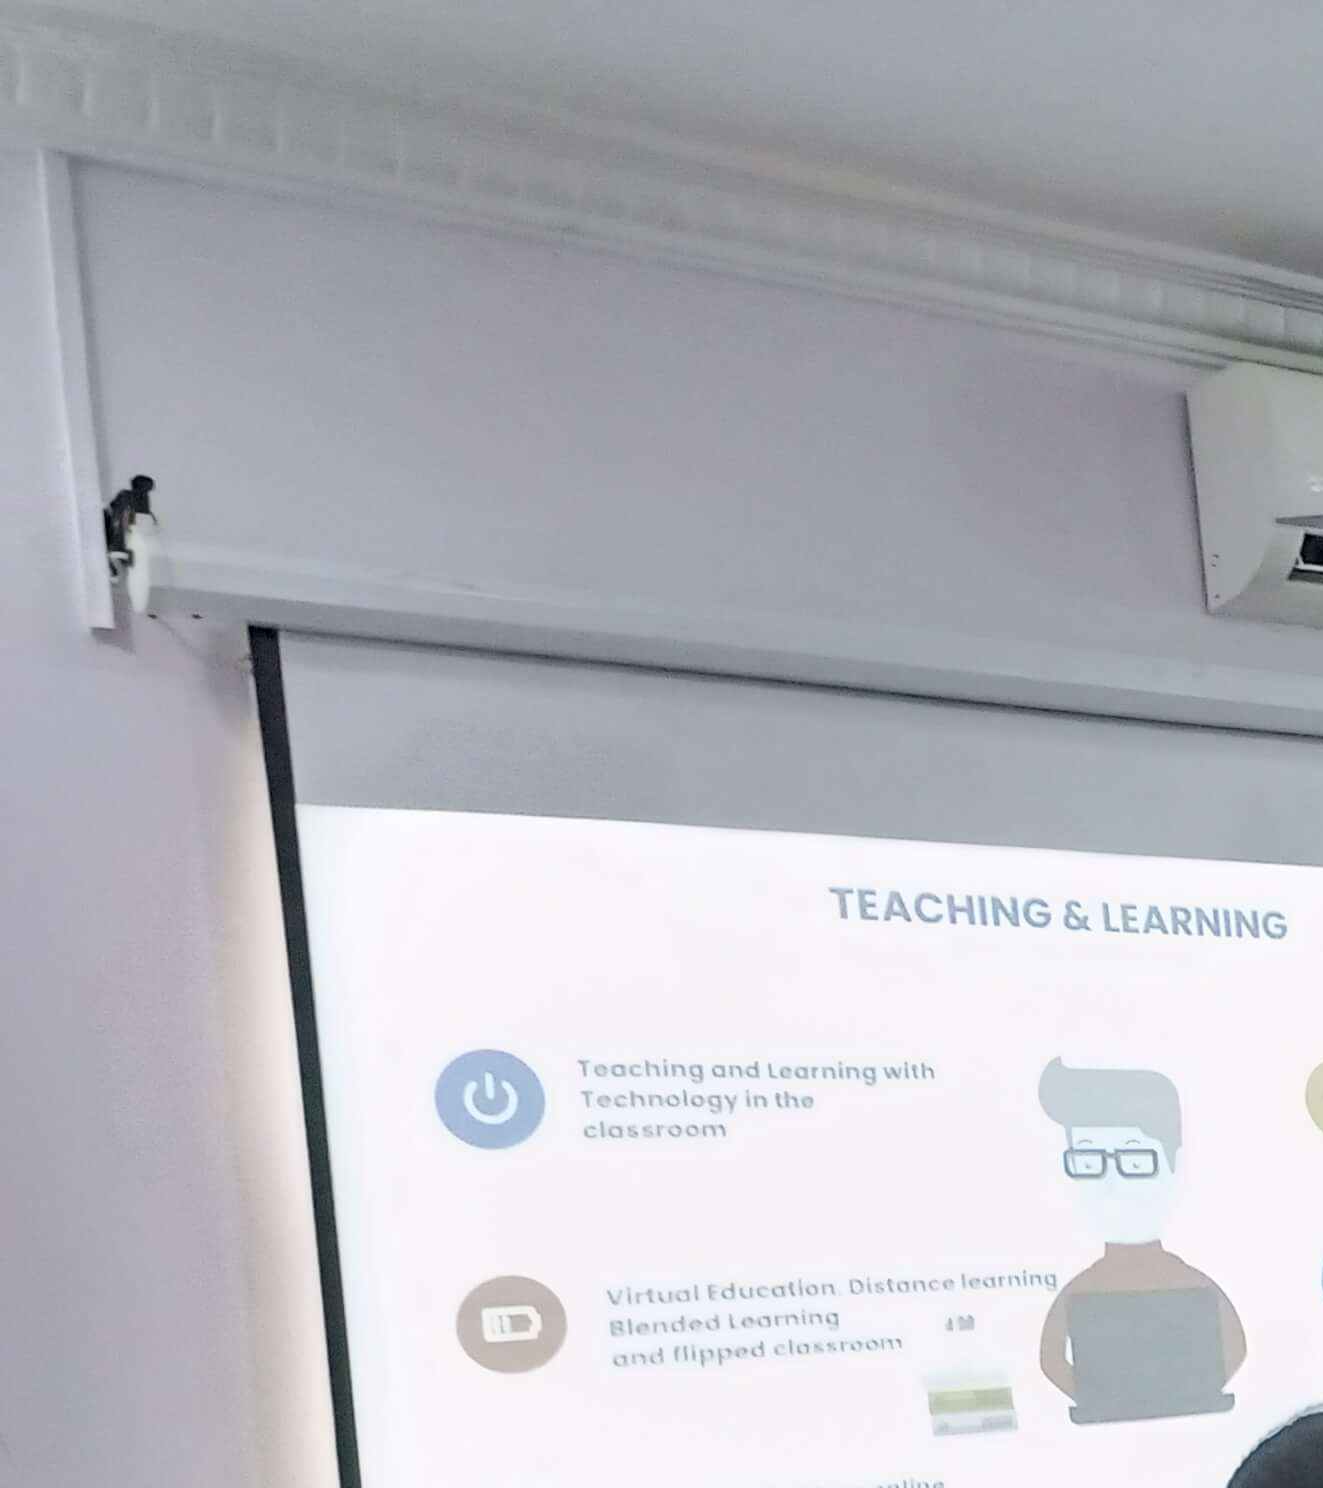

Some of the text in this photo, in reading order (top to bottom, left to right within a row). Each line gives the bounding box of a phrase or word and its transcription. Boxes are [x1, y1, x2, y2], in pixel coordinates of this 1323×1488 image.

[828, 886, 1288, 940] TEACHING & LEARNING
[577, 1059, 936, 1086] Teaching and Learning with
[580, 1089, 815, 1115] Technology in the
[583, 1120, 728, 1140] classroom
[606, 1284, 700, 1306] Virtual
[848, 1276, 955, 1296] Distance
[960, 1269, 1059, 1292] learning
[608, 1307, 841, 1337] Blended Learning
[612, 1334, 904, 1368] and flipped classroom
